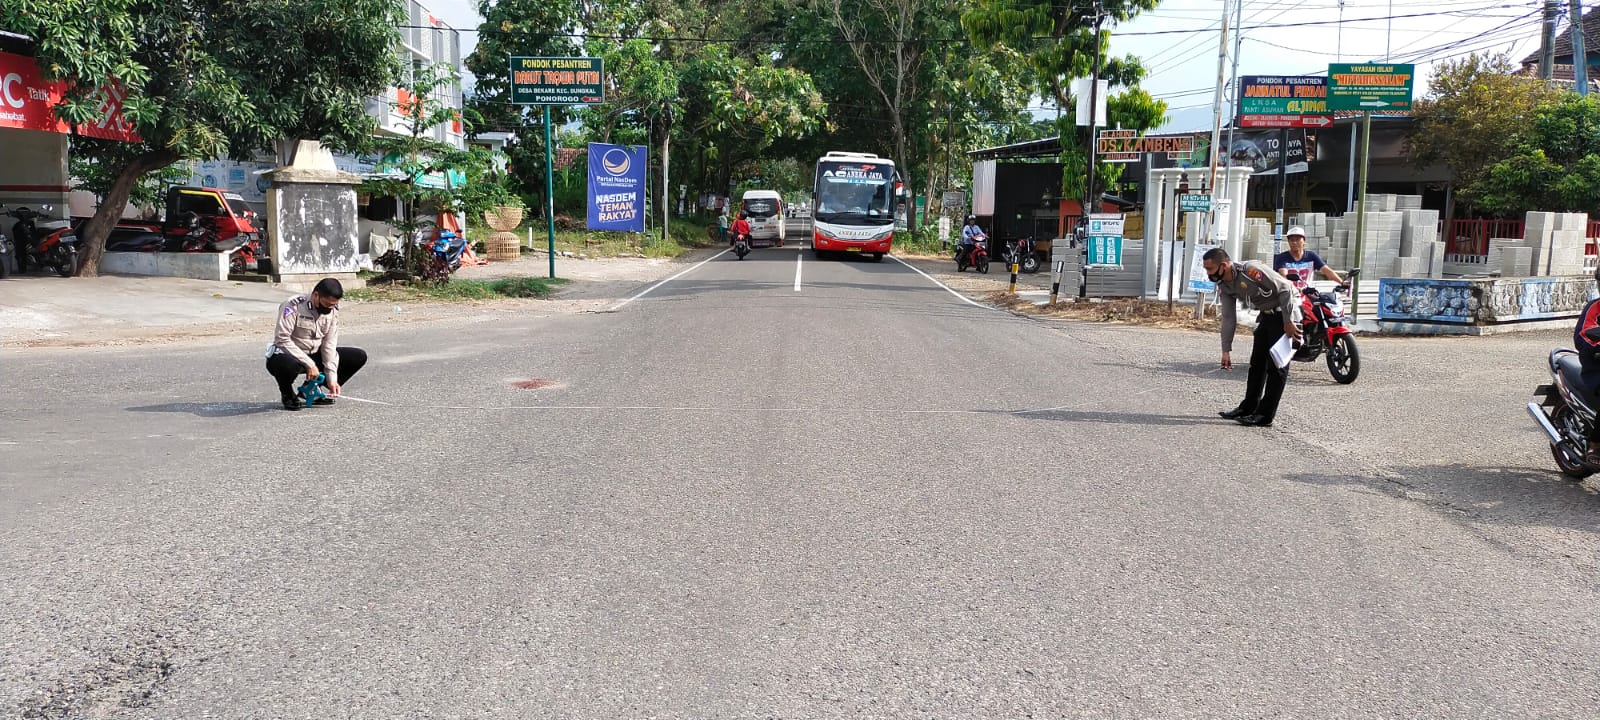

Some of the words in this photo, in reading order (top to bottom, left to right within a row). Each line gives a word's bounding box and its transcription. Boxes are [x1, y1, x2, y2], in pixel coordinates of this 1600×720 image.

[523, 60, 550, 68] PONDOK
[552, 60, 592, 69] PESANTREN
[576, 71, 600, 85] PUTRI
[0, 73, 25, 109] C
[596, 192, 636, 204] NASDEM
[601, 202, 634, 212] TEMAN
[599, 210, 637, 222] RAKYAT
